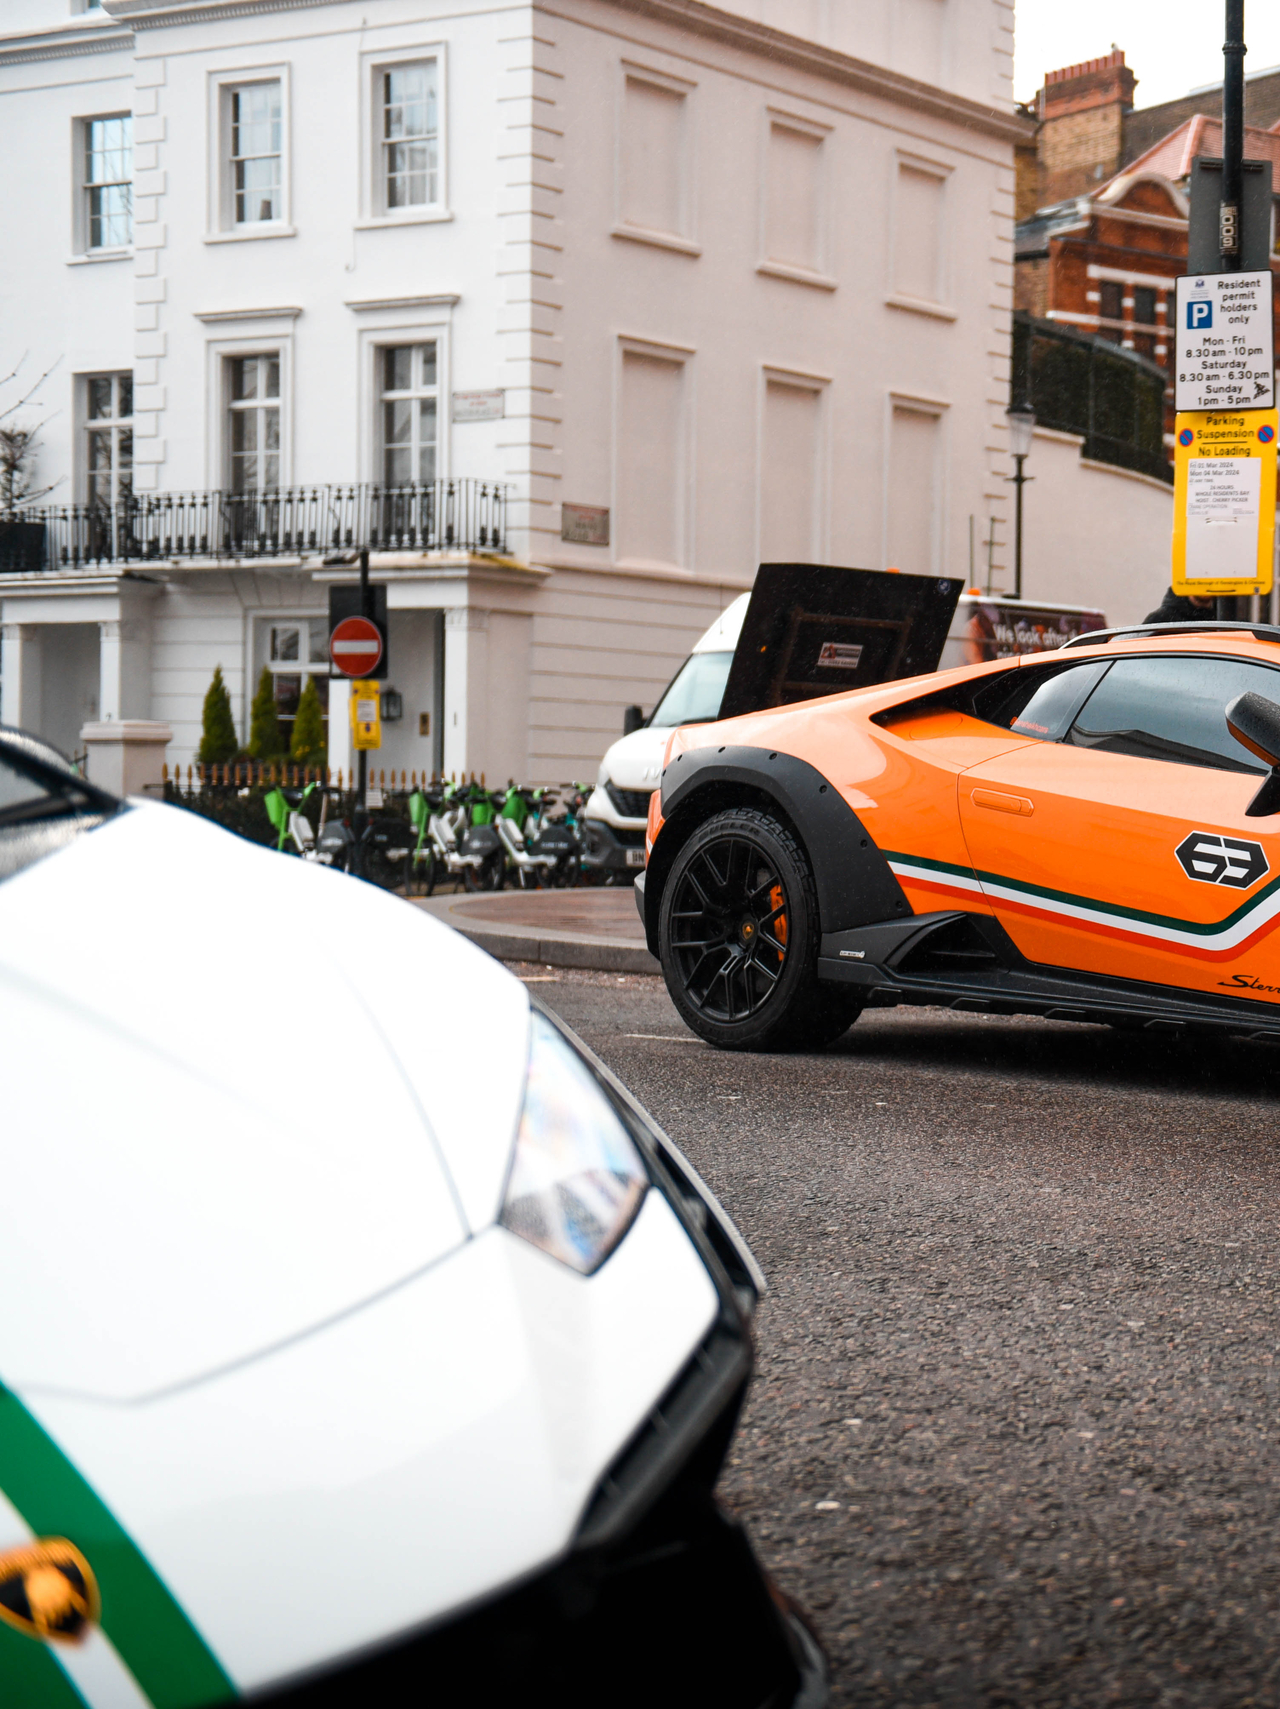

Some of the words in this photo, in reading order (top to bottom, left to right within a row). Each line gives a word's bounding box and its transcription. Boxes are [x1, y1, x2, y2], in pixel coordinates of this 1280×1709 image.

[1217, 279, 1261, 290] Resident
[1222, 291, 1255, 302] permit
[1220, 303, 1258, 312] holders
[1192, 303, 1209, 328] P
[1228, 314, 1250, 324] only
[1203, 337, 1224, 346] Mon
[1232, 335, 1246, 345] Fri
[1201, 359, 1247, 369] Saturday
[1205, 383, 1243, 394] Sunday
[1206, 416, 1245, 426] Parking
[1196, 428, 1254, 439] Suspension
[1198, 447, 1211, 456] No
[1214, 446, 1251, 457] Loading
[992, 623, 1014, 643] We
[1014, 623, 1040, 645] look
[1042, 627, 1068, 646] after
[1175, 831, 1270, 890] 63
